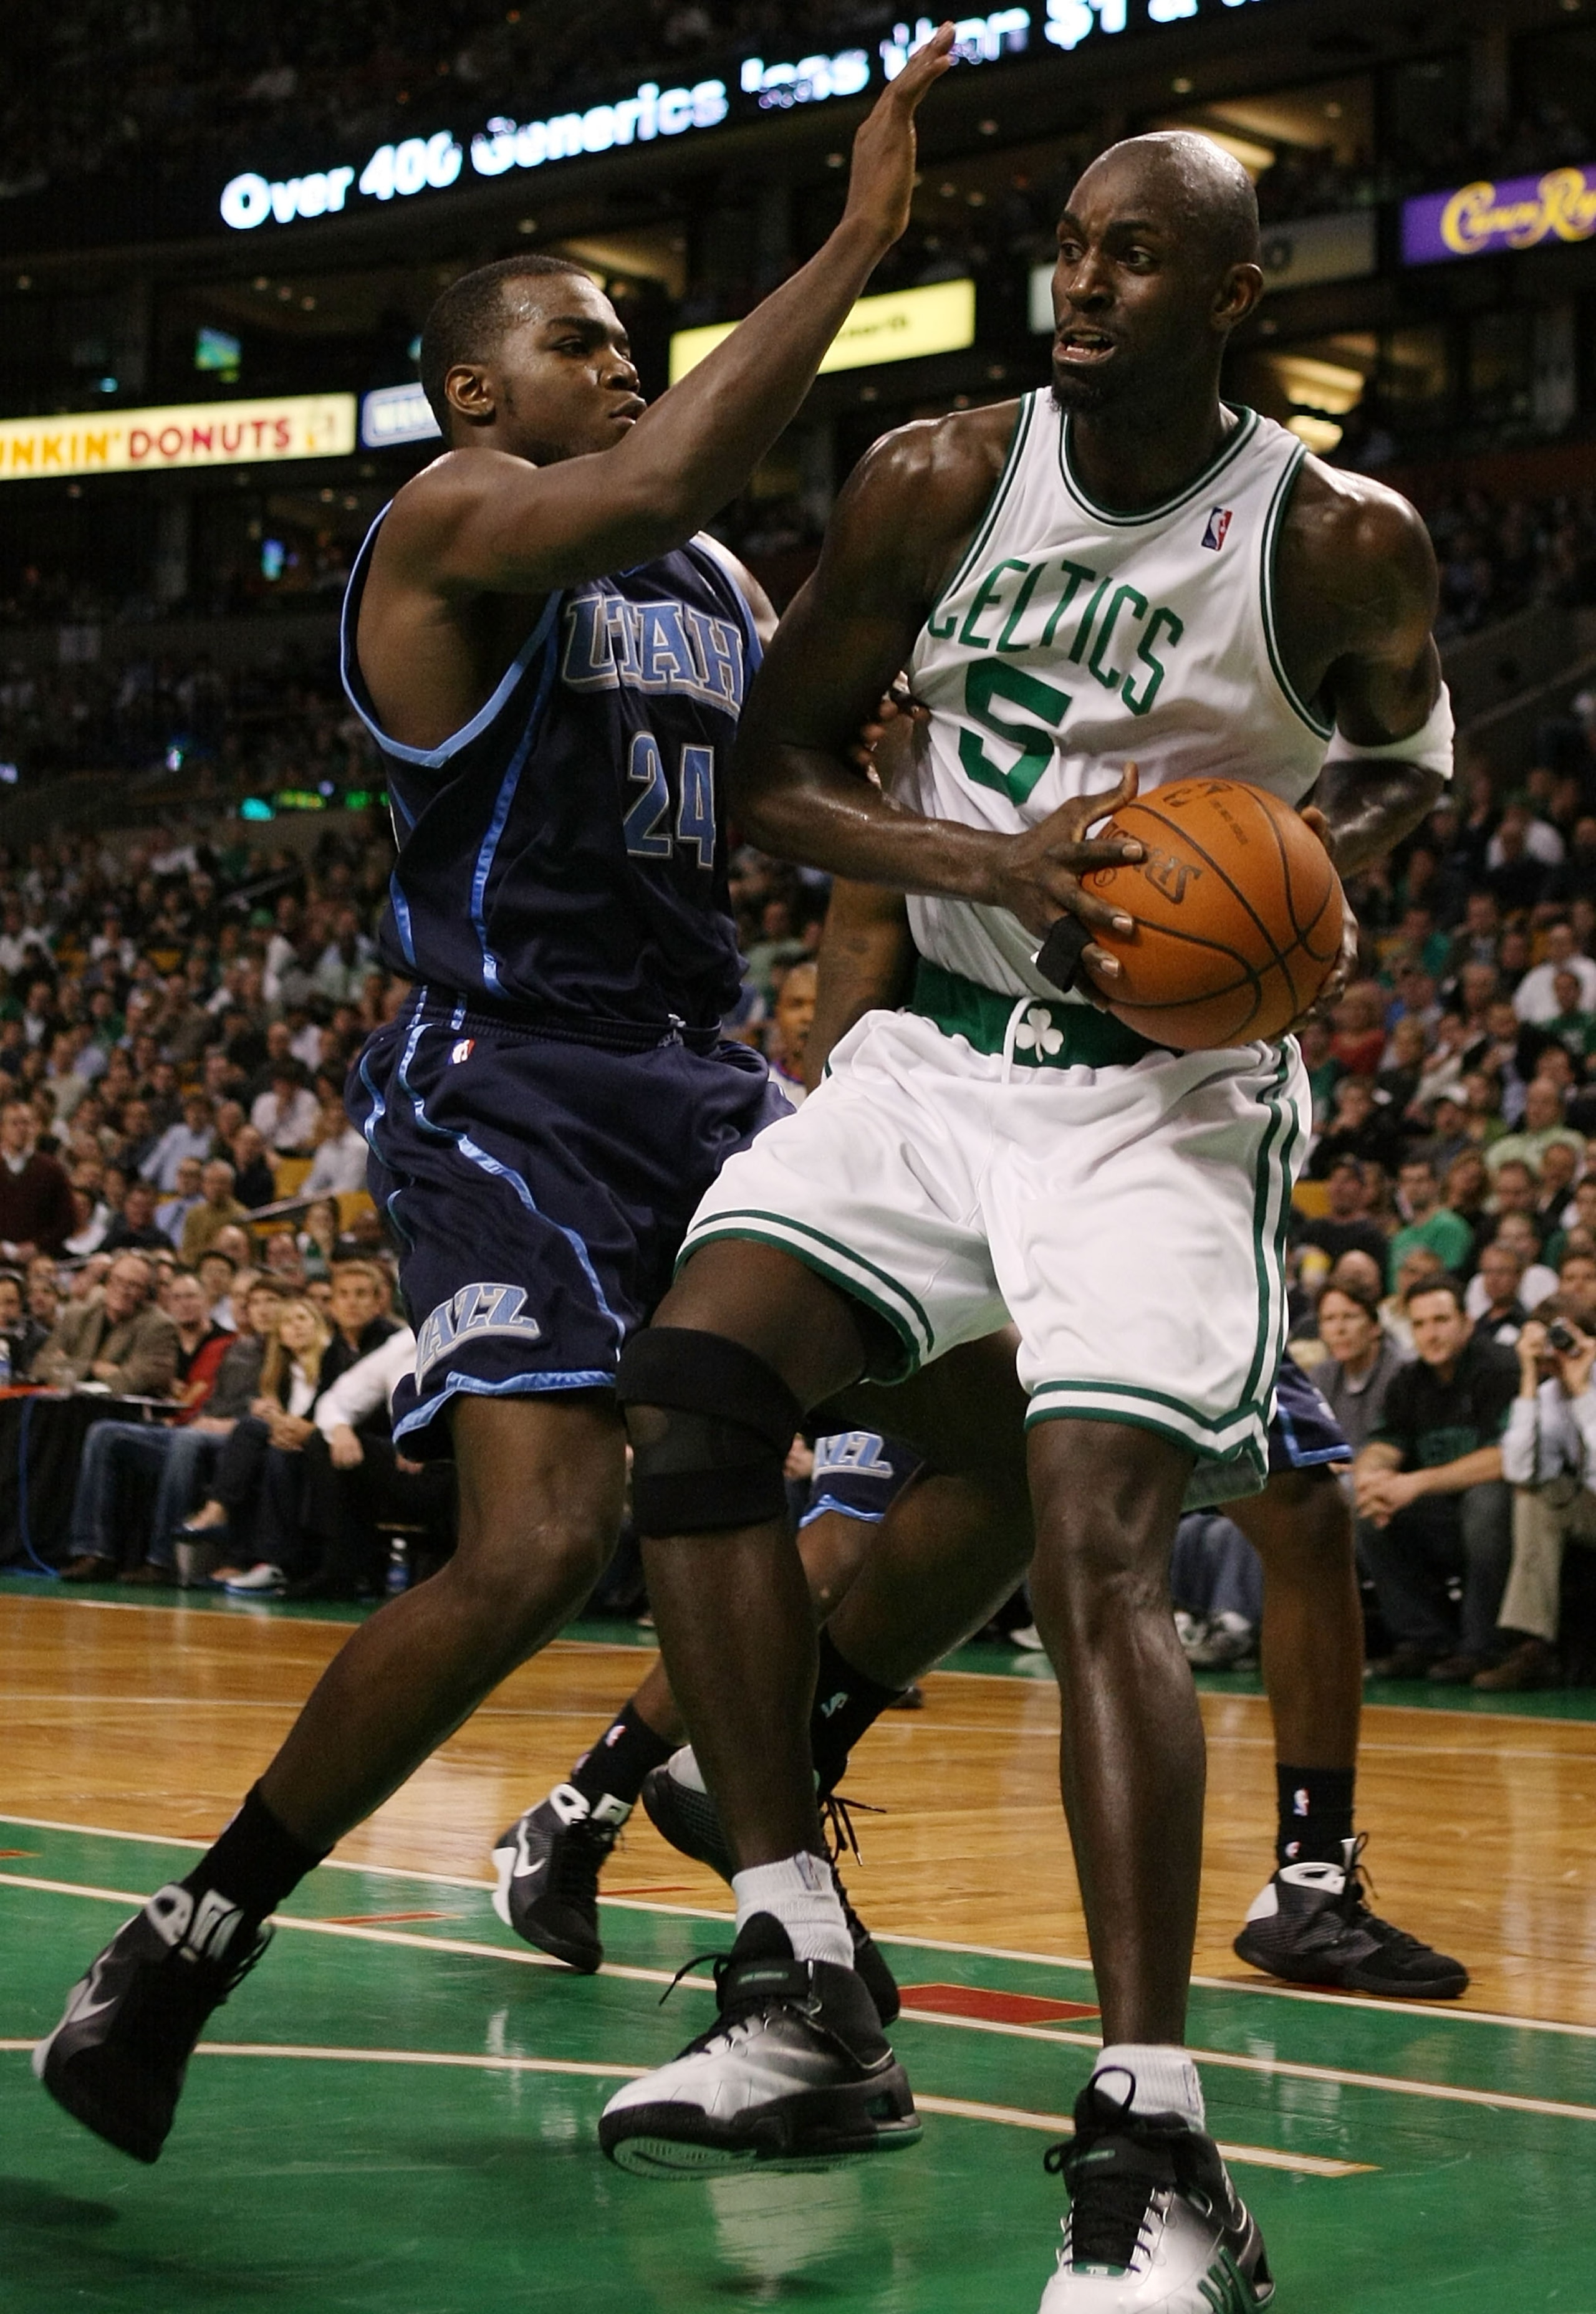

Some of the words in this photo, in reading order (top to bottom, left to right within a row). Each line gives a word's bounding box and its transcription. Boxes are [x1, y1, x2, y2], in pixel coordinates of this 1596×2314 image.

[220, 166, 355, 229] Over
[358, 130, 463, 201] 400
[470, 80, 729, 176] Generics
[129, 416, 292, 461] DONUTS
[562, 592, 744, 722] UTAH
[623, 731, 716, 870] 24
[958, 656, 1072, 807] 5
